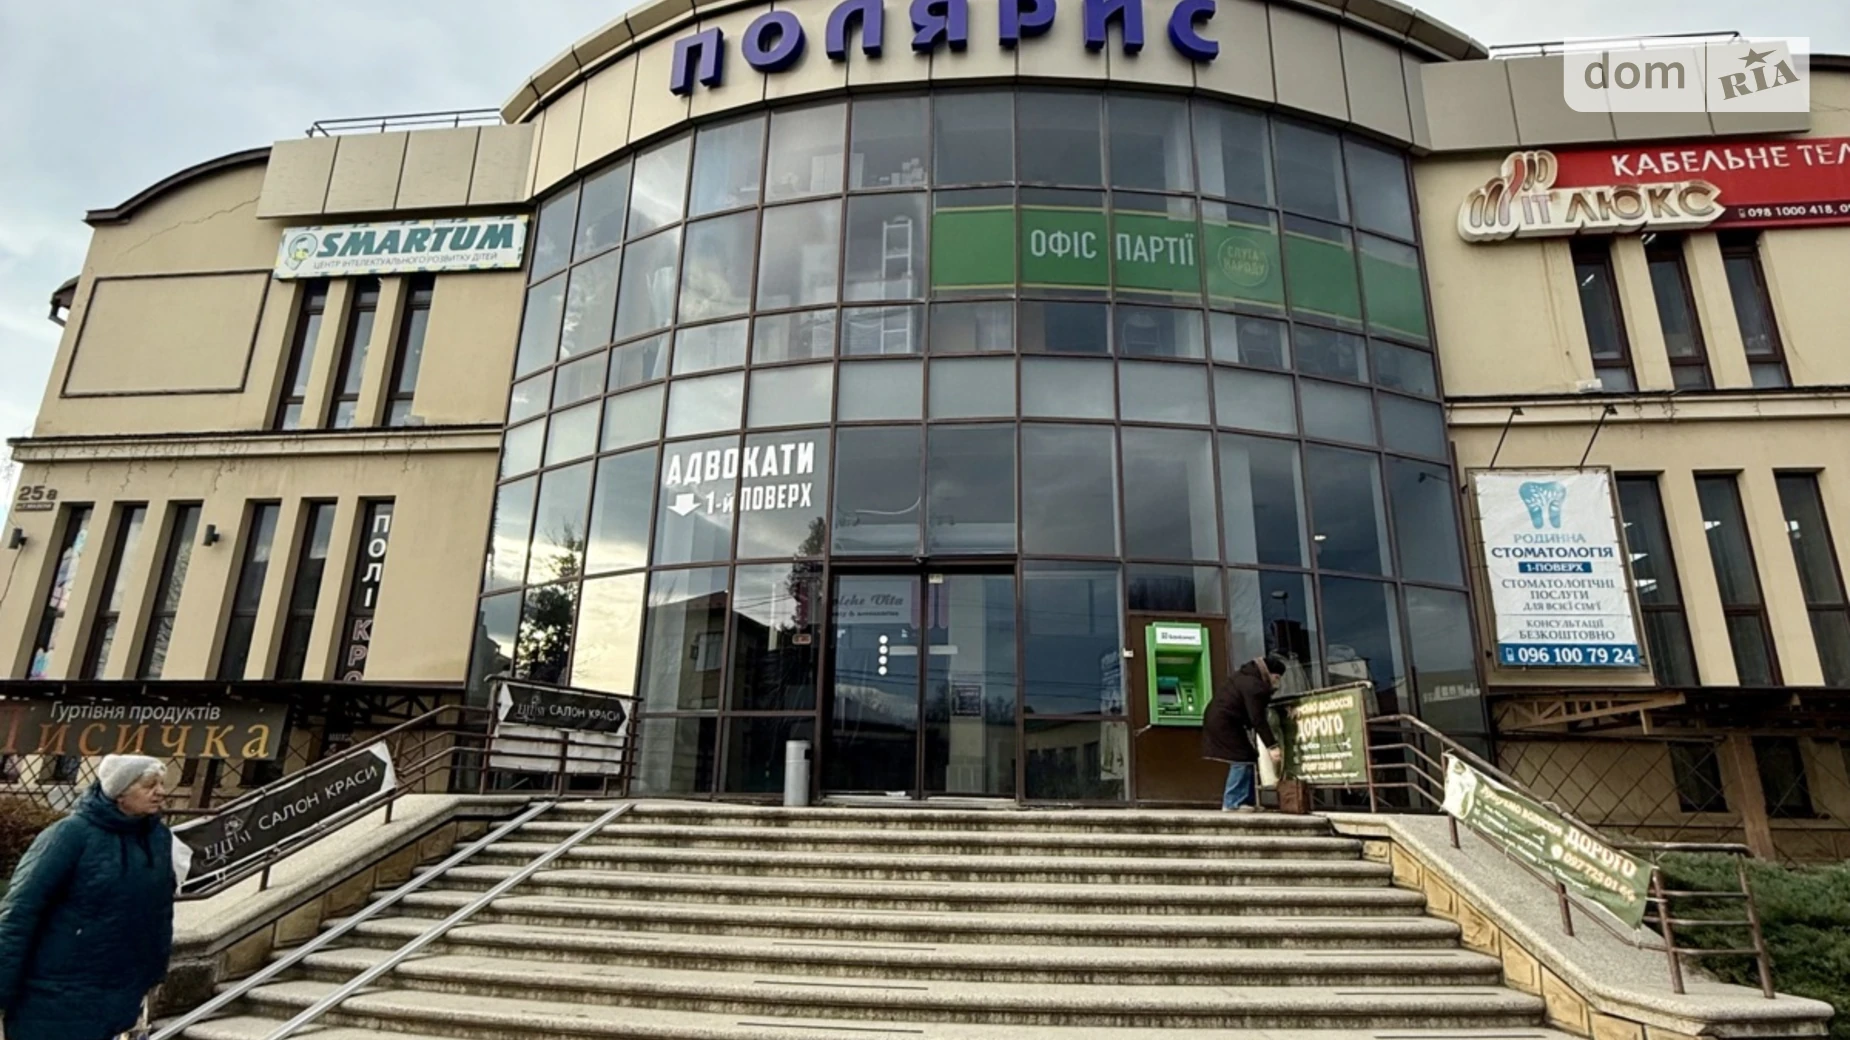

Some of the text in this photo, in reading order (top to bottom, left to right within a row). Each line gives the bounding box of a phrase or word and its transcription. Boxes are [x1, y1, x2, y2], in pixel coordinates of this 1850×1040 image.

[670, 0, 1219, 95] ПОЛЯРИС
[1611, 146, 1790, 177] КАБЕЛЬНЕ
[1565, 182, 1717, 223] ЛЮКС
[1748, 207, 1772, 217] 098
[1776, 205, 1806, 216] 1000
[316, 223, 514, 257] SMARTUM
[1031, 229, 1195, 266] ОФІС ПАРТІЇ
[313, 260, 340, 270] ЦЕНТР
[666, 442, 815, 485] АДВОКАТИ
[740, 482, 813, 512] ПОВЕРХ
[1513, 533, 1586, 544] РОДИННА
[1491, 547, 1614, 558] СТОМАТОЛОГІЯ
[1526, 563, 1584, 572] 1-ПОВЕРХ
[1501, 579, 1615, 589] СТОМАТОЛОГІЧНІ
[1530, 590, 1589, 600] ПОСЛУГИ
[1523, 602, 1544, 611] ДЛЯ
[1526, 619, 1604, 629] КОНСУЛЬТАЦІЇ
[1519, 630, 1615, 640] БЕЗКОШТОВНО
[1518, 647, 1635, 663] 096 100 79 24
[50, 700, 221, 723] Гуртівня продуктів
[549, 704, 586, 718] САЛОН
[588, 709, 621, 722] КРАСИ
[258, 765, 377, 830] САЛОН КРАСИ
[1563, 826, 1638, 879] ДОРОГО
